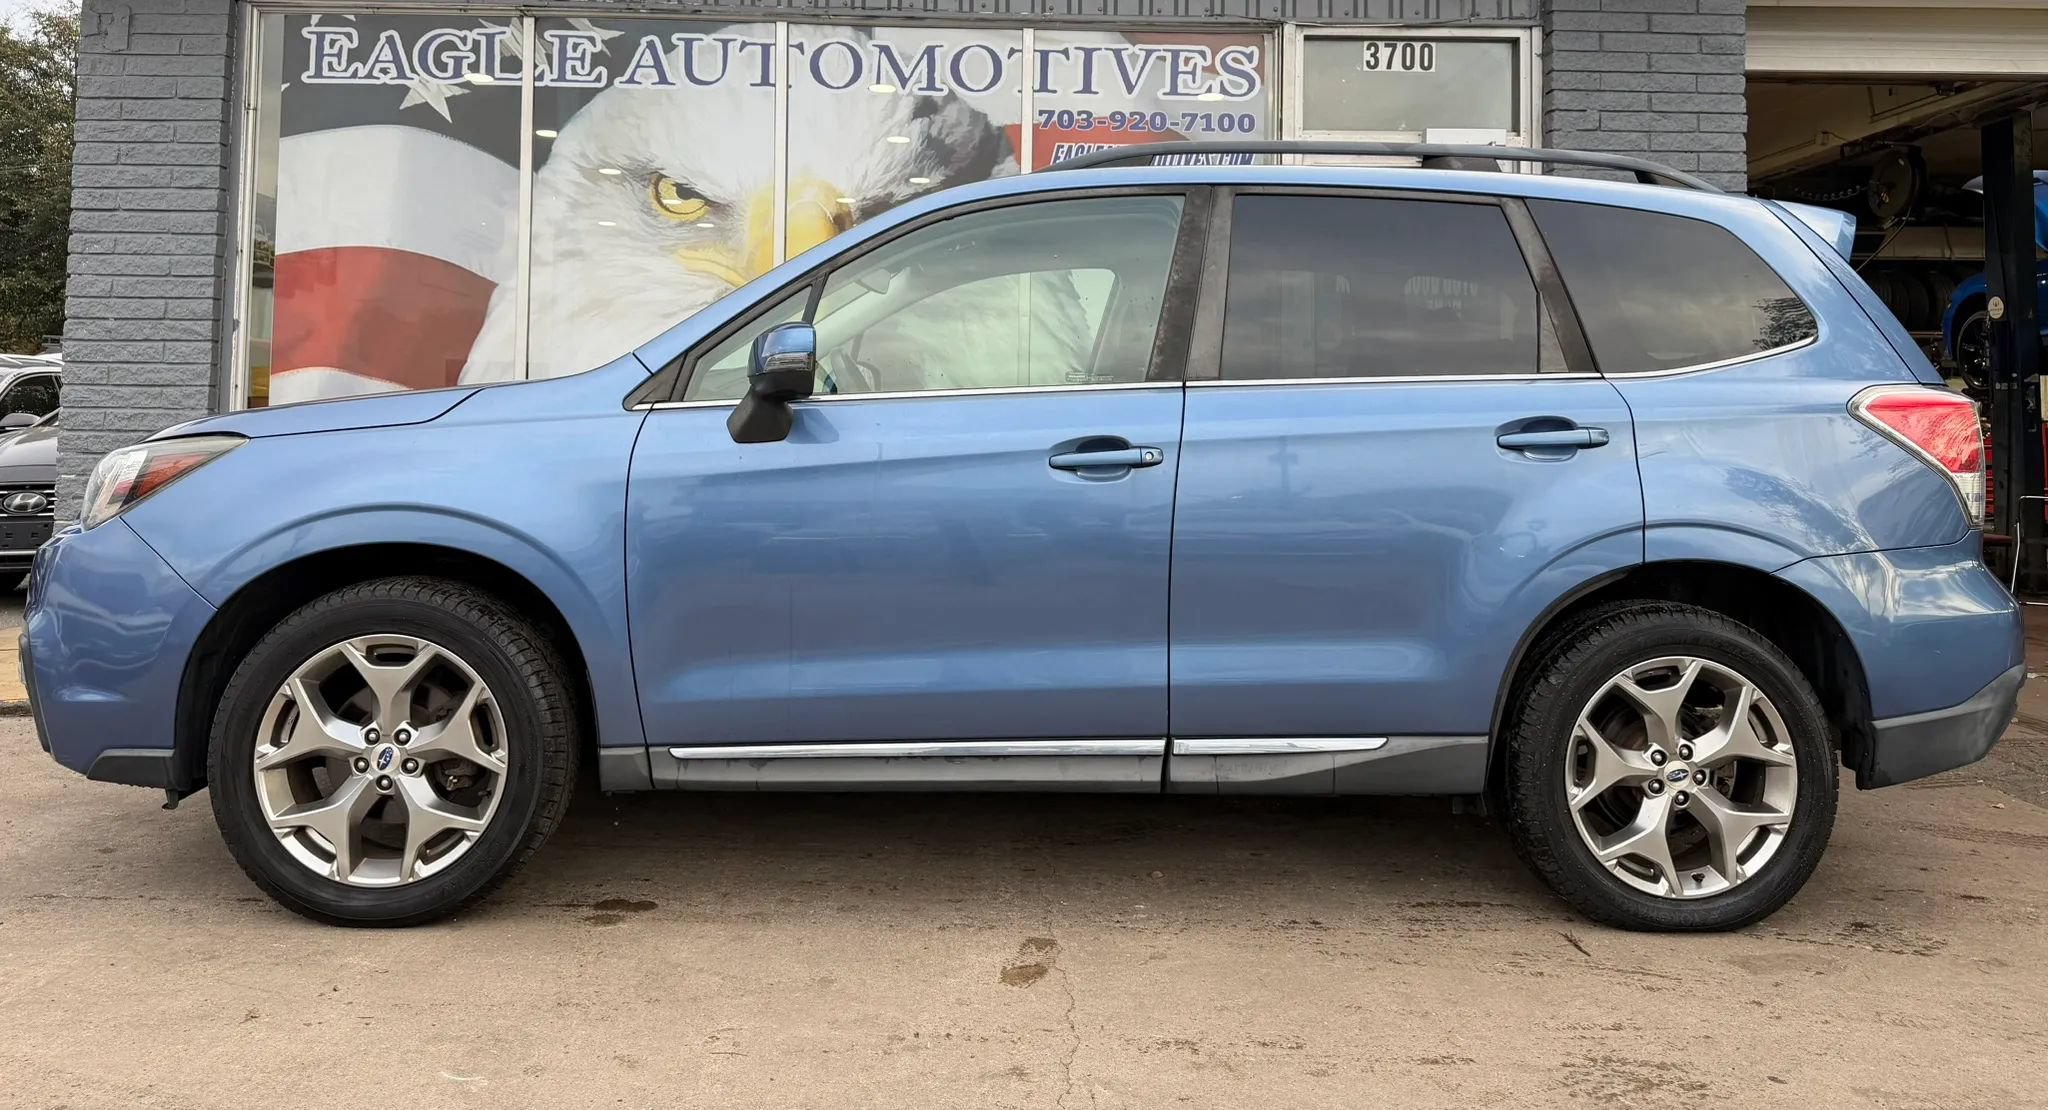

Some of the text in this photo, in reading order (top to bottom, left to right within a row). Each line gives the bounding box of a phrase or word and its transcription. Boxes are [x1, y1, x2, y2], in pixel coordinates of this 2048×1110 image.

[302, 27, 1261, 101] EAGLE AUTOMOTIVES
[1365, 42, 1434, 71] 3700
[1037, 108, 1257, 133] 703-920-7100
